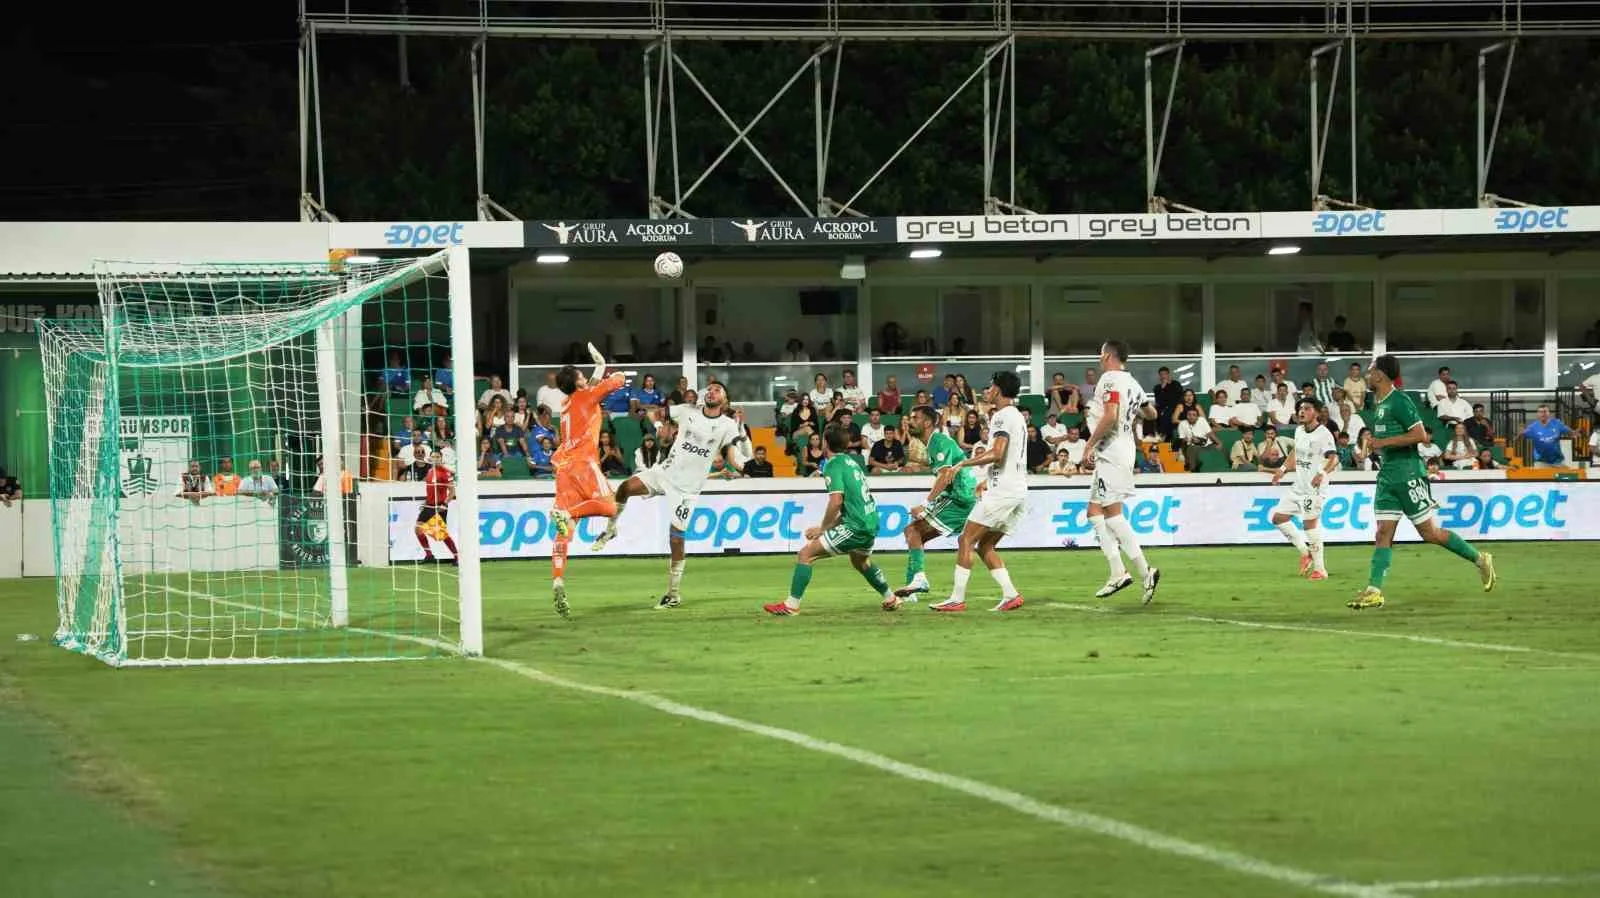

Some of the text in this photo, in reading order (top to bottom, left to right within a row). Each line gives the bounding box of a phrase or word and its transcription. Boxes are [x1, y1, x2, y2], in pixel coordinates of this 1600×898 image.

[626, 222, 693, 235] ACROPOL
[812, 220, 878, 233] ACROPOL
[906, 216, 1069, 239] grey beton
[1088, 214, 1251, 237] grey beton
[1311, 210, 1386, 235] opet
[1494, 207, 1568, 232] opet
[384, 222, 465, 247] opet
[573, 231, 618, 243] AURA
[760, 228, 805, 240] AURA
[681, 441, 711, 458] opet
[675, 505, 690, 520] 68
[1052, 495, 1181, 535] oet
[1244, 487, 1372, 532] oet
[1437, 489, 1568, 534] opet
[685, 501, 805, 547] opet
